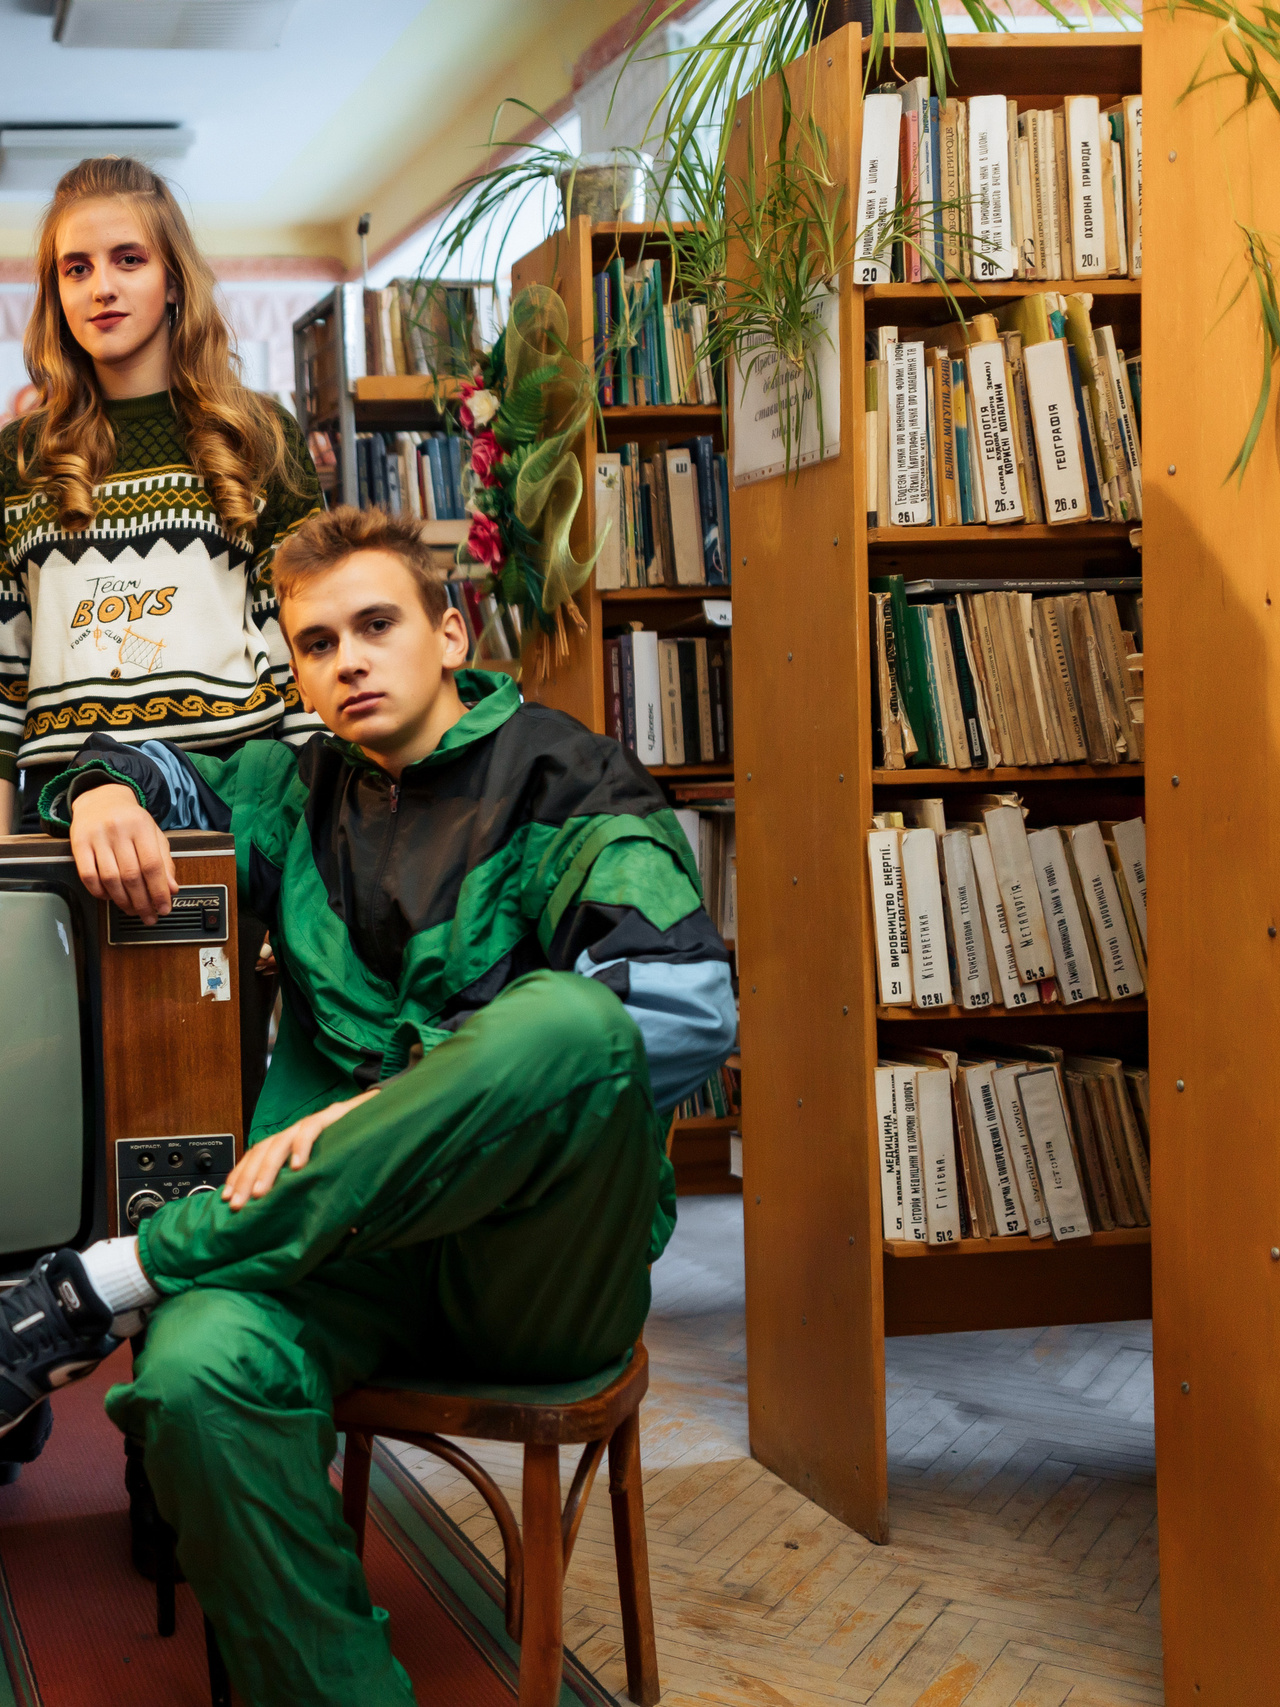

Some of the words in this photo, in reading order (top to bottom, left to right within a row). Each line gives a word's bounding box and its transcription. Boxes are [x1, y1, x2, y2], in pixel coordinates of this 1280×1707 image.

[945, 127, 954, 177] ПРИРОДЕ
[1081, 141, 1091, 187] ПРИРОДИ
[1082, 195, 1094, 239] ОХОРОНА
[862, 267, 877, 282] 20
[994, 383, 1008, 432] КОПАЛИНИ
[980, 405, 995, 460] ГЕОЛОГІЯ
[1048, 403, 1067, 470] ГЕОГРАФІЯ
[1123, 413, 1138, 467] ПРИТЯЖЕНИЕ
[1001, 437, 1014, 475] КОРИСНІ
[994, 499, 1015, 513] 26.3
[1054, 498, 1077, 513] 26.8
[70, 586, 178, 629] BOYS
[86, 576, 141, 599] Team
[879, 844, 894, 886] ЕНЕРГІЇ.
[172, 896, 220, 908] Tauras
[885, 893, 900, 968] ВИРОБНИЦТВО
[1070, 989, 1084, 1001] 35
[1116, 984, 1130, 996] 36
[883, 1110, 895, 1173] МЕДИЦИНА.
[1006, 1220, 1018, 1232] 57
